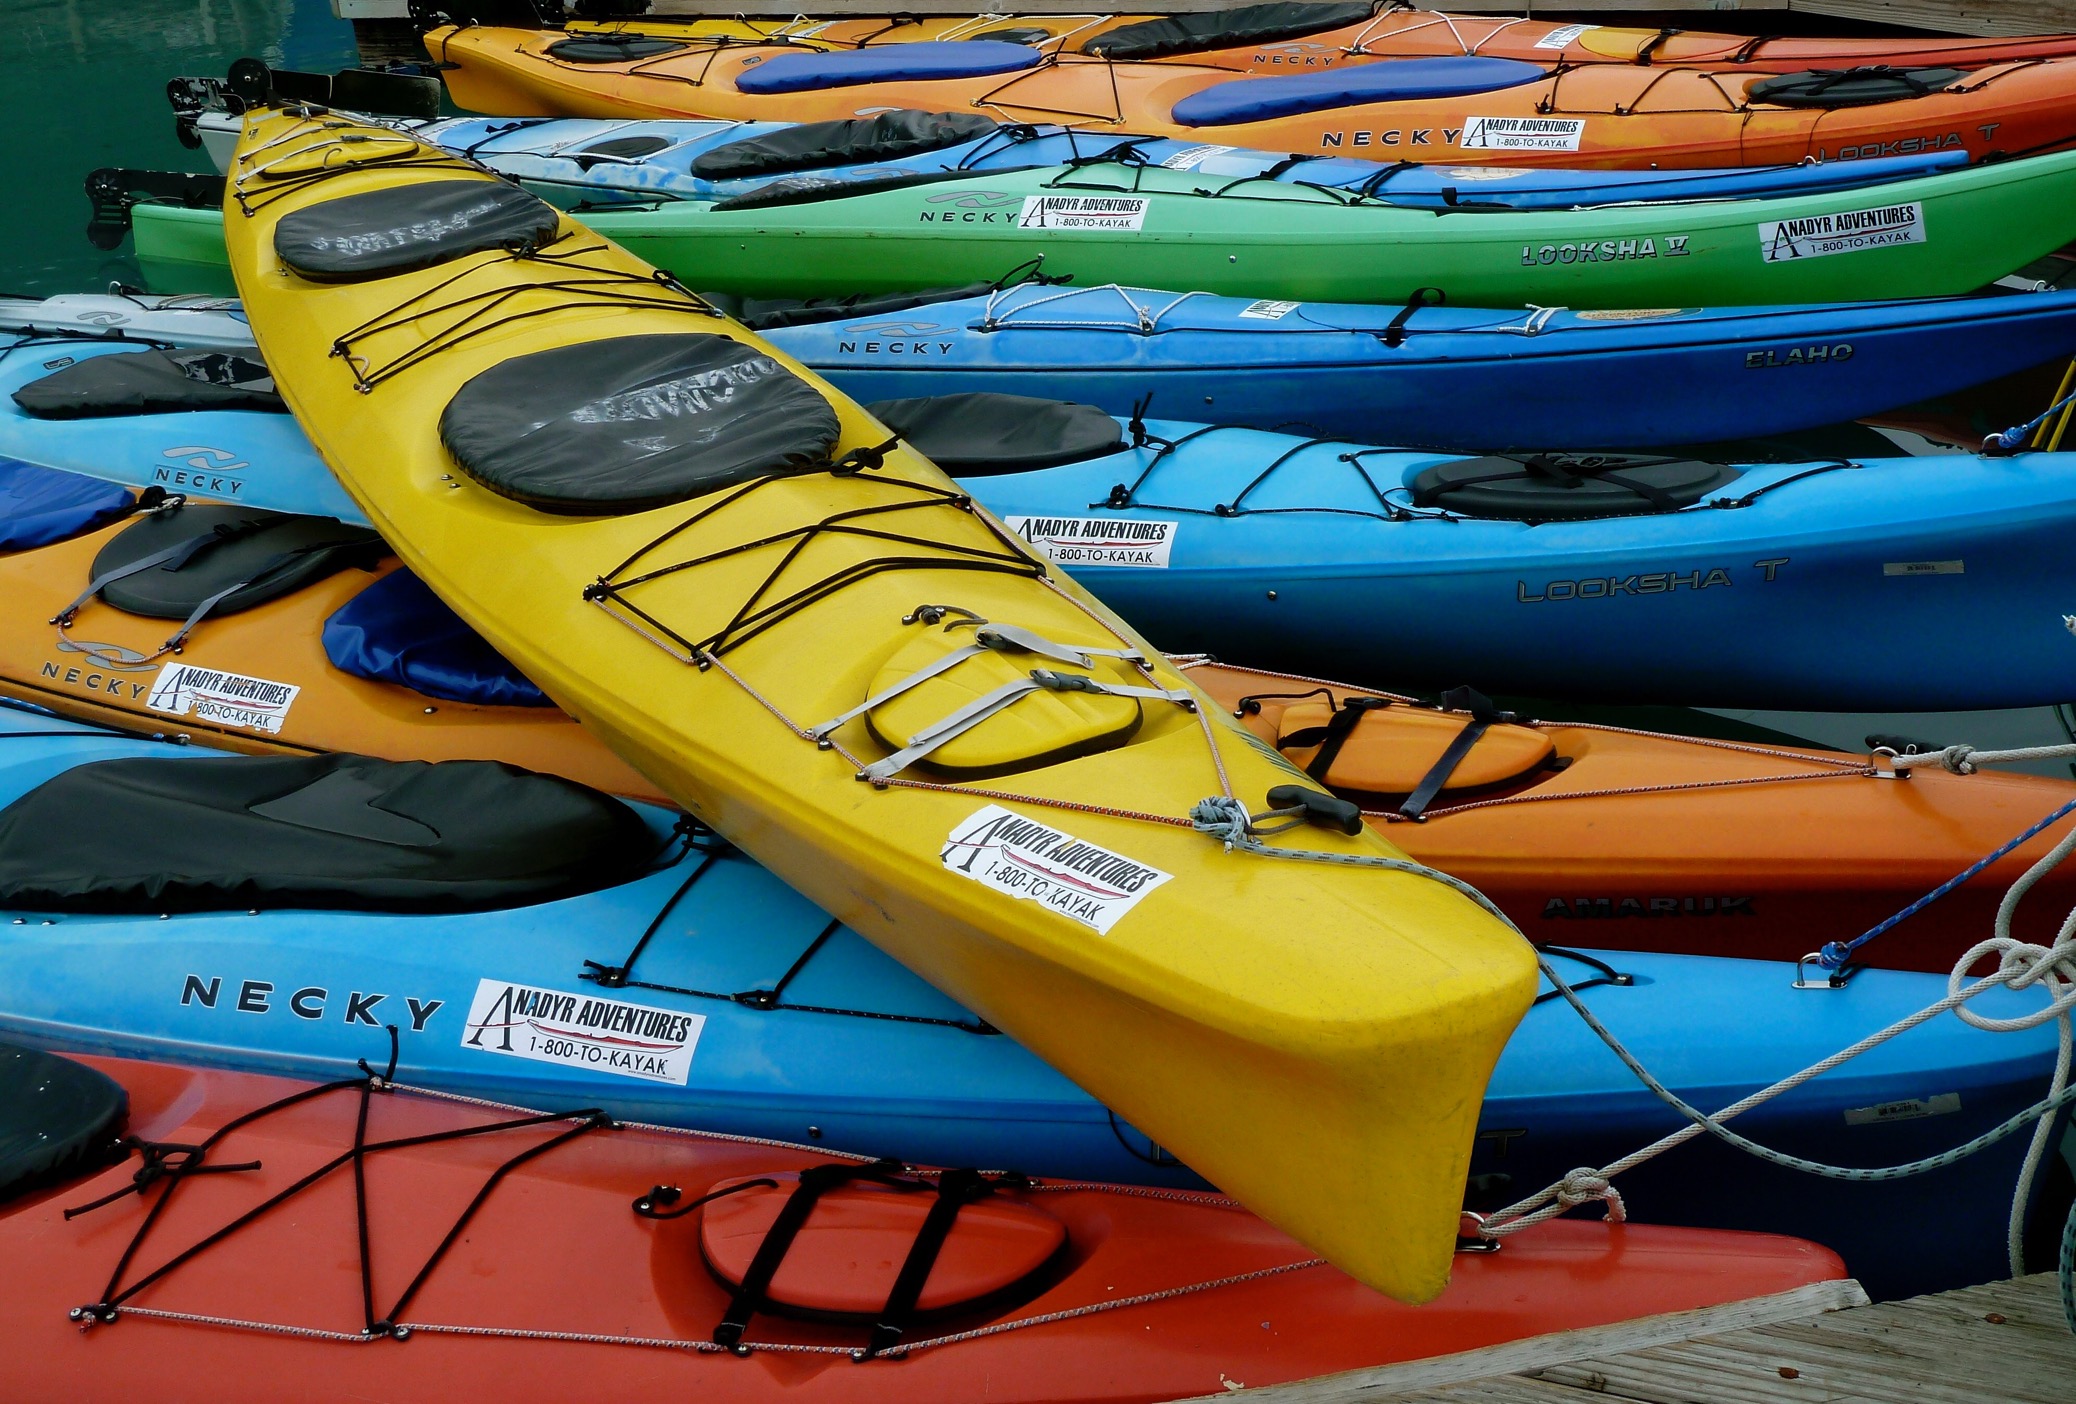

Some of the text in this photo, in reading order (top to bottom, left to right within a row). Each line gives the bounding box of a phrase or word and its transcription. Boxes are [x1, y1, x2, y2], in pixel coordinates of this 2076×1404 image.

[1253, 54, 1334, 66] NECKY
[1321, 128, 1463, 147] NECKY
[1463, 118, 1579, 147] ANADYR ADVENTURES
[1495, 137, 1569, 148] 1-800-TO-KAYAK
[1819, 123, 2001, 163] LOOKSHA T
[919, 211, 1018, 223] NECKY
[1020, 197, 1143, 228] ANADYR ADVENTURES
[1054, 217, 1132, 228] 1-800-TO-KAYAK
[1768, 205, 1916, 261] ANADYR ADVENTURES
[1811, 232, 1911, 253] 1-800-TO-KAYAK
[1521, 238, 1657, 265] LOOKSHA
[838, 342, 953, 355] NECKY
[1745, 344, 1853, 368] ELAHO
[155, 468, 242, 494] NECKY
[1081, 520, 1168, 541] ADVENTURES
[1048, 548, 1153, 563] 1-800-TO-KAYAK
[1517, 558, 1790, 603] LOOKSHA T
[41, 660, 148, 700] NECKY
[149, 666, 293, 711] ANADYR ADVENTURES
[187, 700, 271, 727] 1800TO-KAYAK
[939, 813, 1159, 893] ANADYR ADVENTURES
[984, 860, 1105, 921] 1-800-TOKAYAK
[1540, 897, 1757, 919] AMARUK
[180, 974, 445, 1032] NECKY
[466, 986, 694, 1052] ANADYR ADVENTURES
[529, 1036, 669, 1076] 1-800-TO-KAYAK
